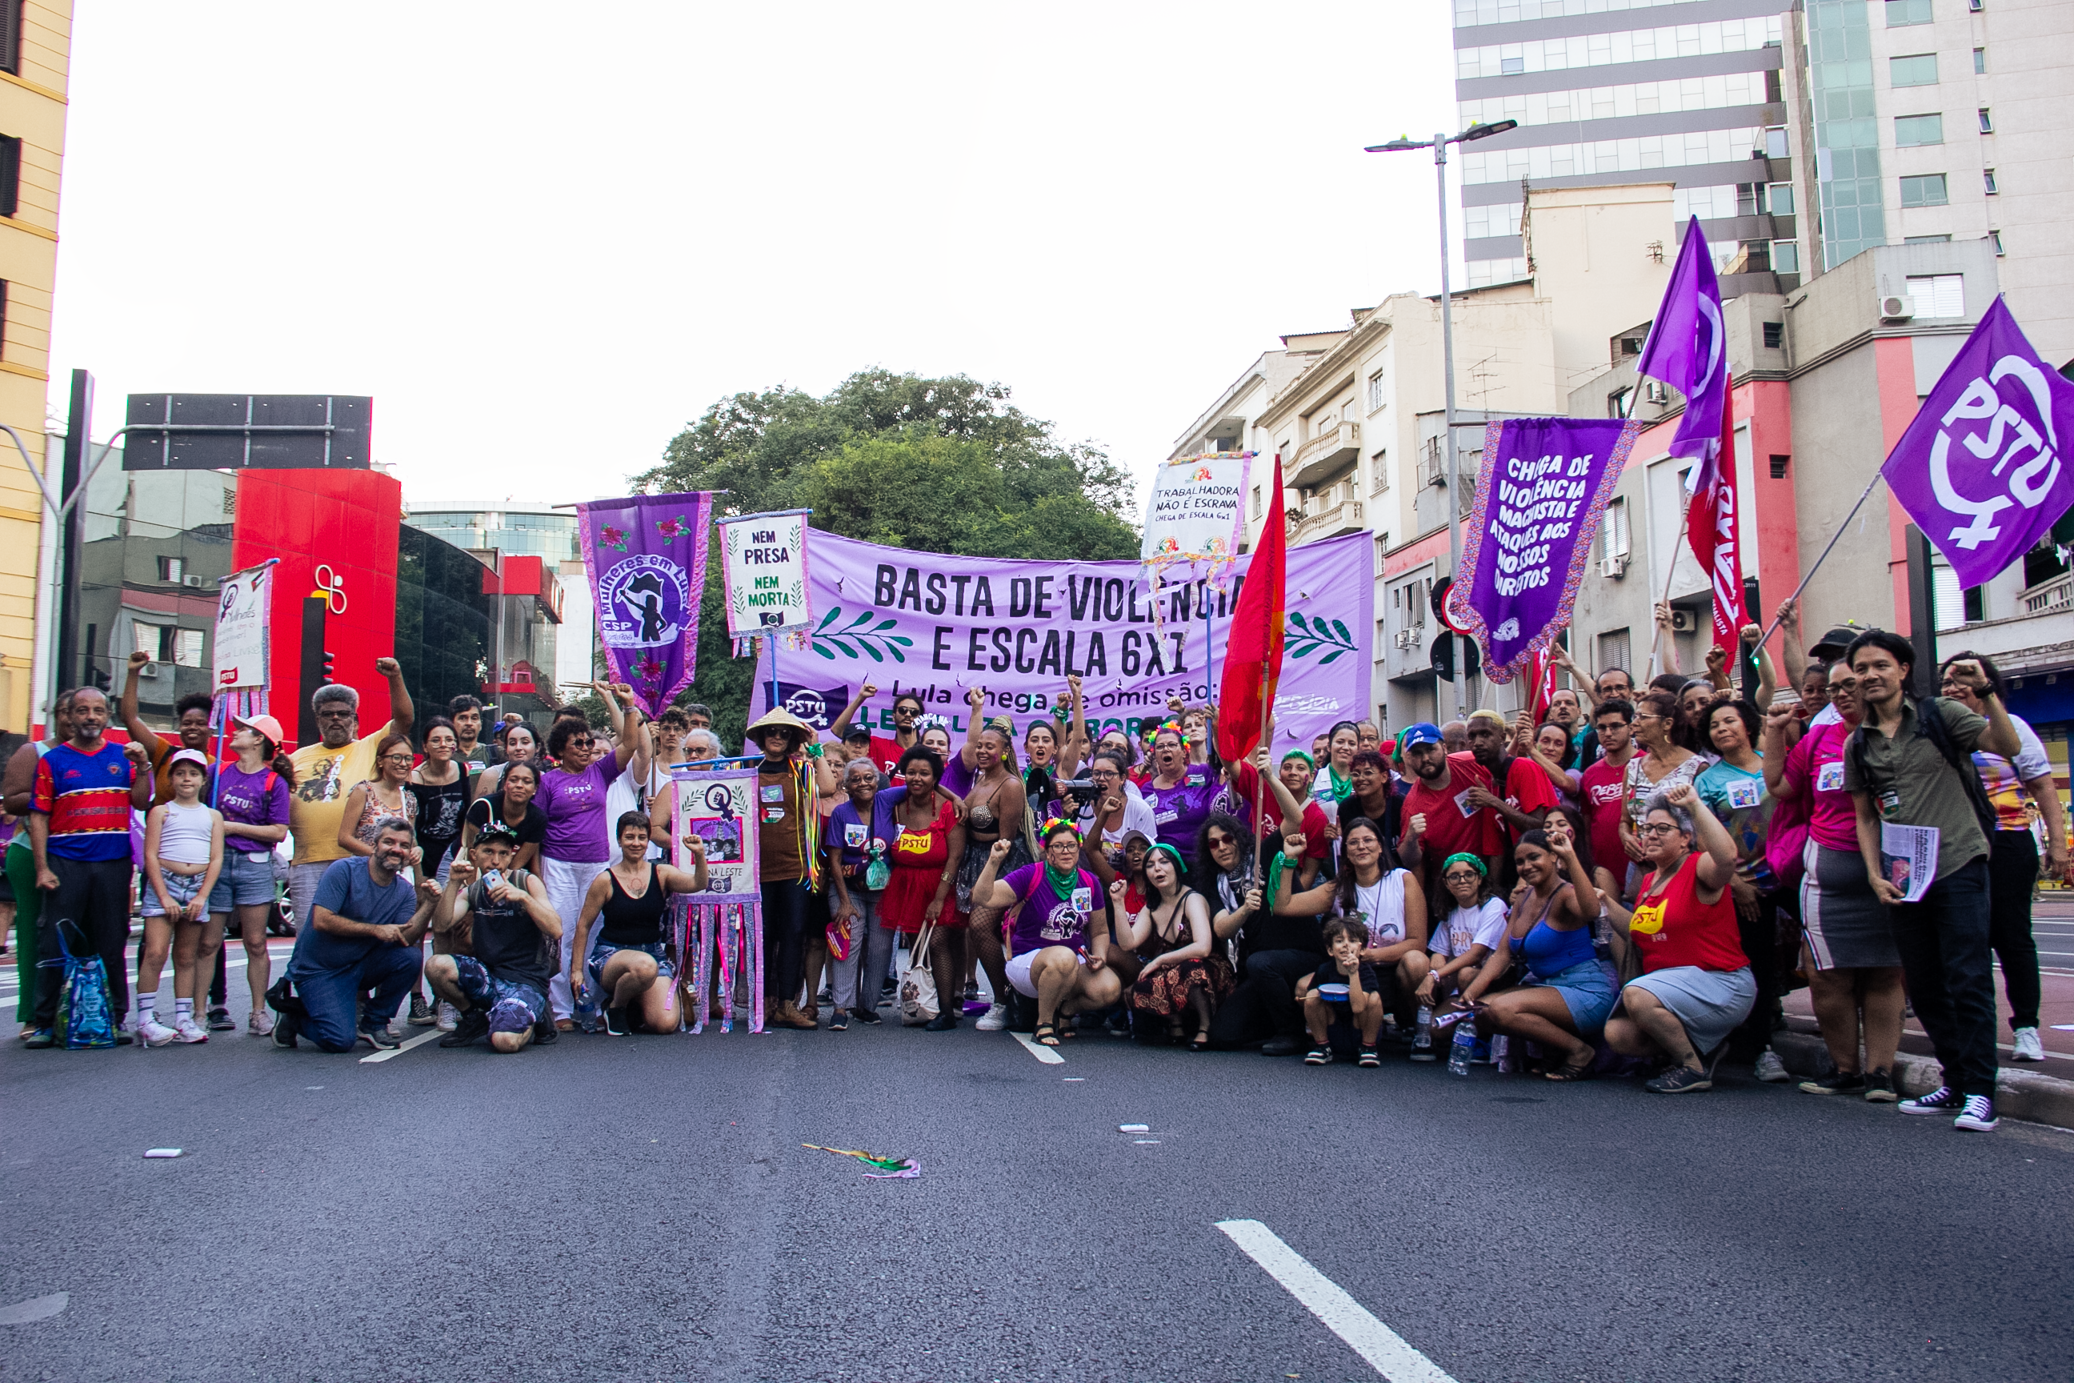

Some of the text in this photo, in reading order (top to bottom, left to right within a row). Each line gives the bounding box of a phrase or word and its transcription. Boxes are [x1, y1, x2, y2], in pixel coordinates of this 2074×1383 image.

[1940, 376, 2062, 509] PSTU
[1567, 454, 1593, 477] DE
[1156, 485, 1240, 498] TRABALHADORA
[1498, 476, 1586, 508] VIOLÊNCIA
[1155, 496, 1238, 512] NÃO É ESCRAVA
[1155, 512, 1176, 522] CHEGA
[1189, 511, 1214, 519] ESCALA
[1499, 500, 1581, 529] MACHISTA E
[752, 530, 776, 544] NEM
[1489, 519, 1572, 553] ATAQUES AOS
[744, 547, 790, 565] PRESA
[1497, 544, 1550, 574] NOSSOS
[600, 556, 644, 615] Mulheres
[649, 556, 672, 571] em
[754, 576, 779, 589] NEM
[748, 592, 790, 607] MORTA
[874, 564, 994, 617] BASTA
[1009, 576, 1054, 619] DE
[602, 621, 632, 630] CSP
[932, 626, 954, 670] E
[967, 627, 1107, 678] ESCALA
[892, 680, 952, 704] Lula
[963, 686, 1048, 713] chega
[1100, 682, 1219, 708] omissão:
[785, 699, 826, 713] PSTU
[568, 784, 592, 794] PSTU
[223, 793, 250, 809] PSTU
[902, 838, 928, 848] PSTU
[720, 867, 743, 876] LESTE
